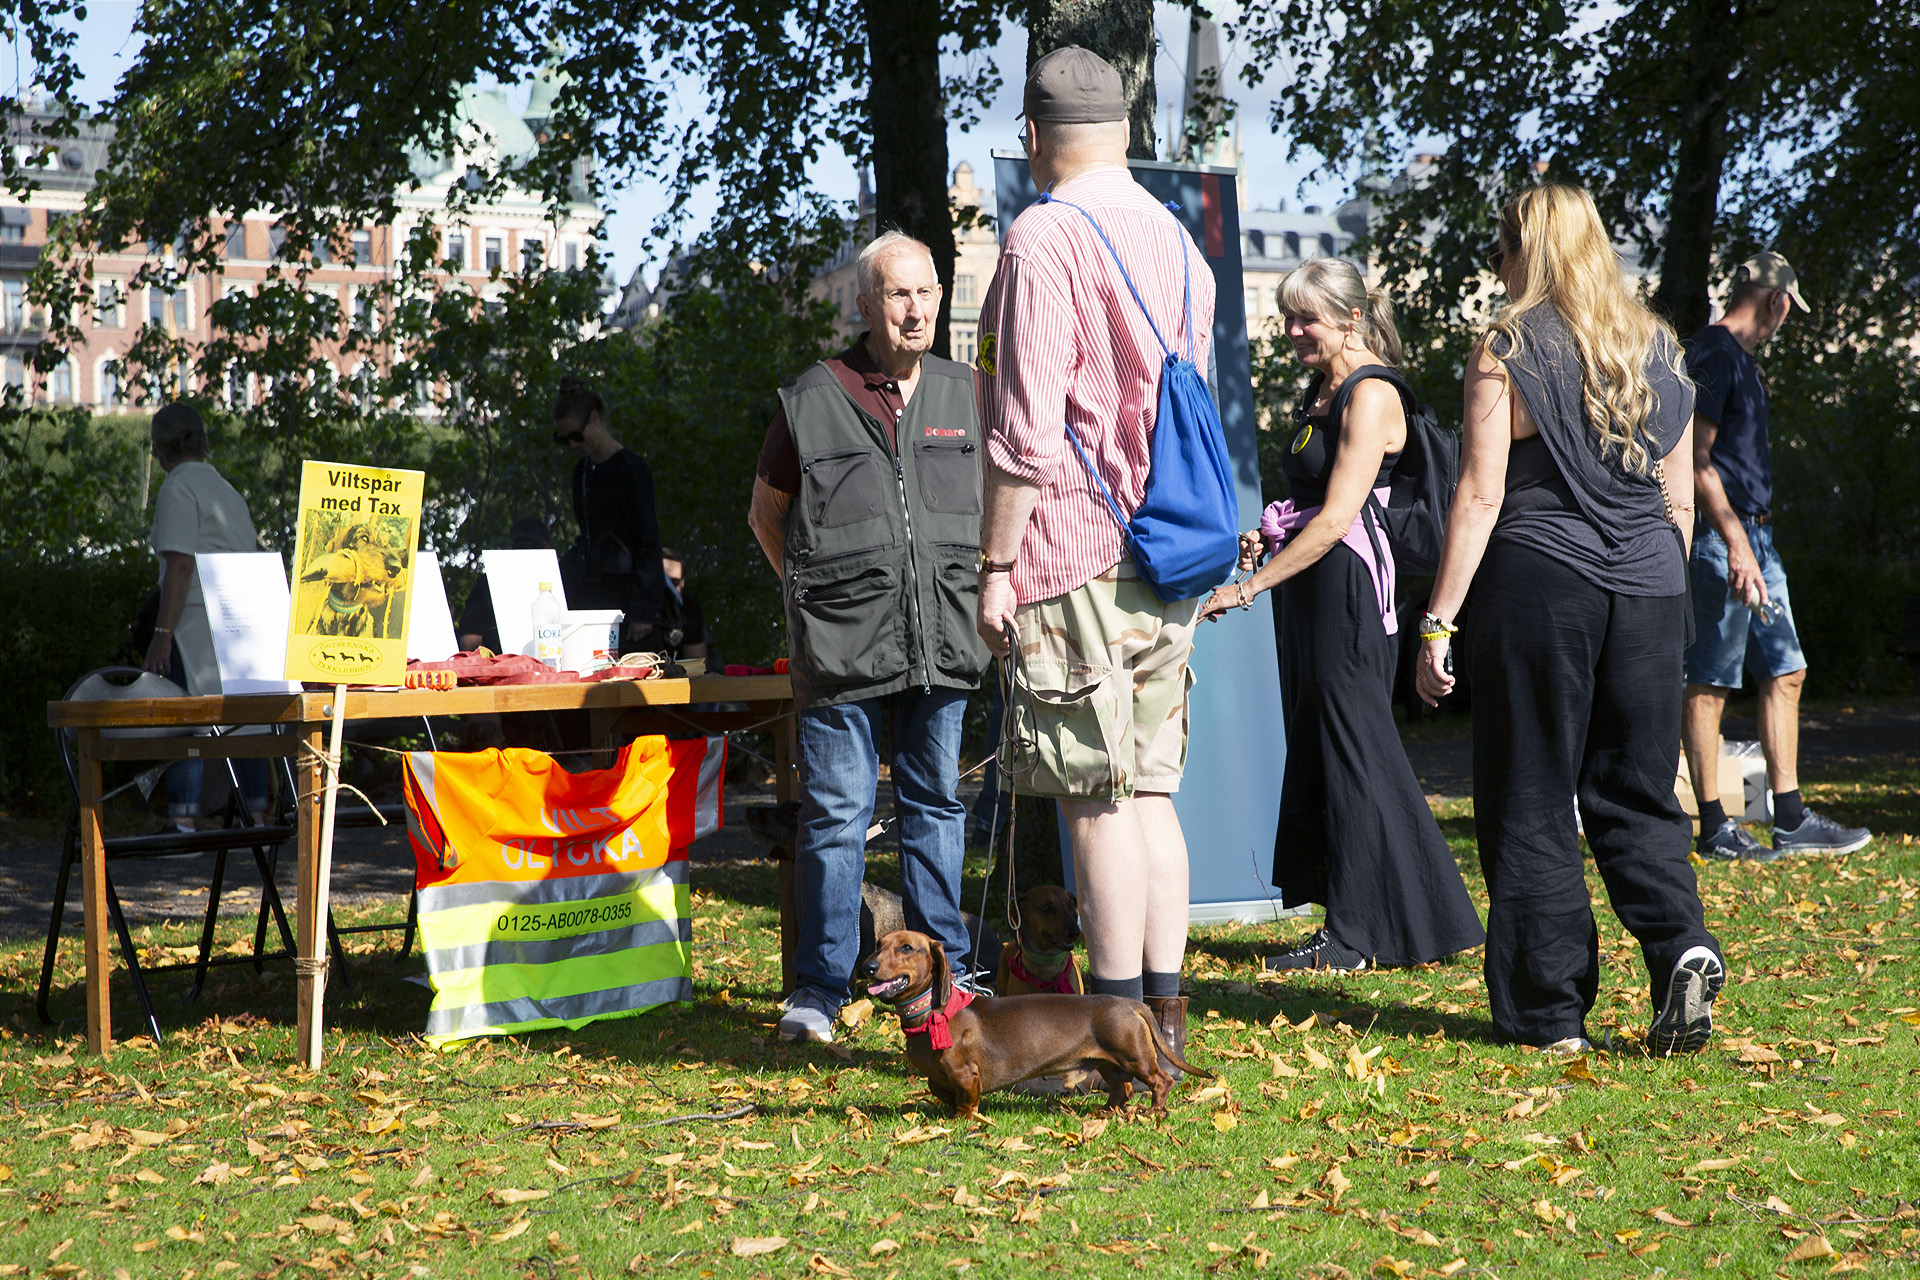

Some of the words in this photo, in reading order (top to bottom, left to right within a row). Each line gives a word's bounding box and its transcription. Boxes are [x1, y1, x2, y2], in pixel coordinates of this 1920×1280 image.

[925, 426, 966, 437] Domare
[328, 470, 402, 494] Viltspår
[321, 496, 361, 512] med
[368, 497, 401, 515] Tax
[316, 659, 372, 674] TAXKLUBBEN
[540, 807, 619, 833] VILT
[502, 827, 644, 869] OLYCKA
[497, 902, 632, 931] 0125-AB0078-0355
